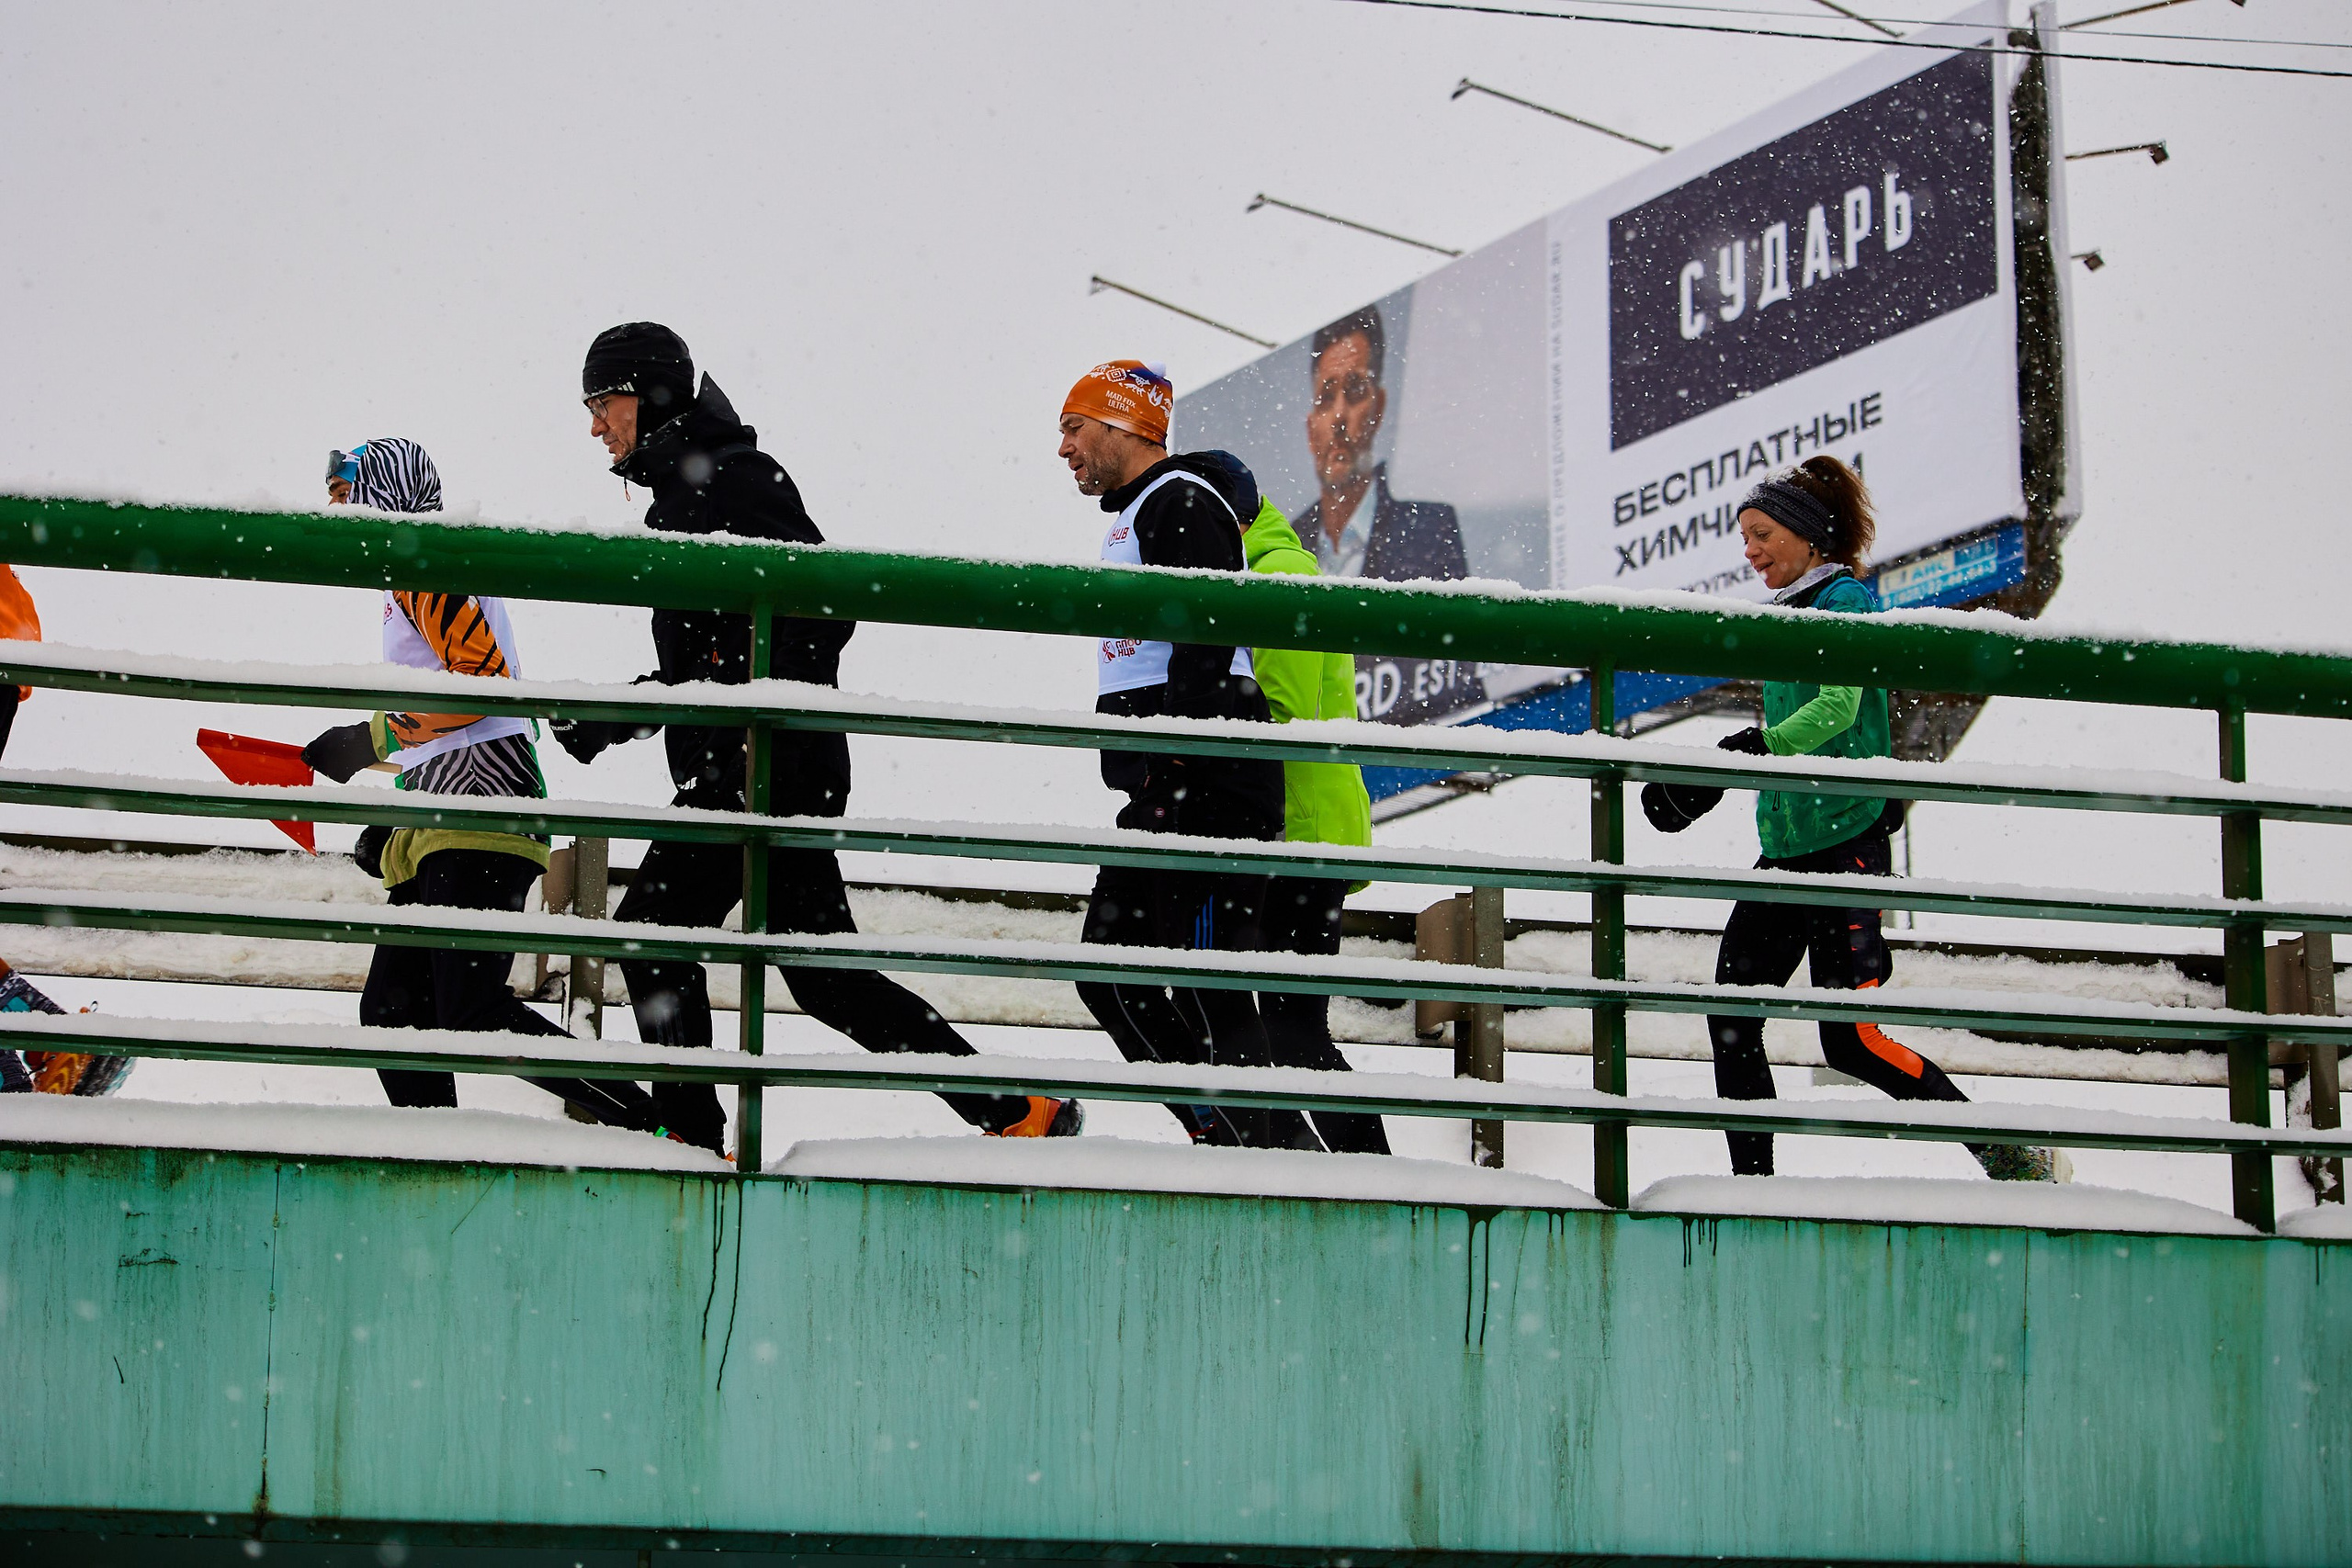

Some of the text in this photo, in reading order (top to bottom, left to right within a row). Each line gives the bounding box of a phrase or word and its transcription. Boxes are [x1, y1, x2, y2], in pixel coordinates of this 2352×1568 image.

[1679, 172, 1913, 340] СУДАРЬ
[1105, 389, 1136, 409] MAD FOX
[1107, 399, 1130, 413] ULTRA
[1613, 392, 1883, 526] БЕСПЛАТНЫЕ
